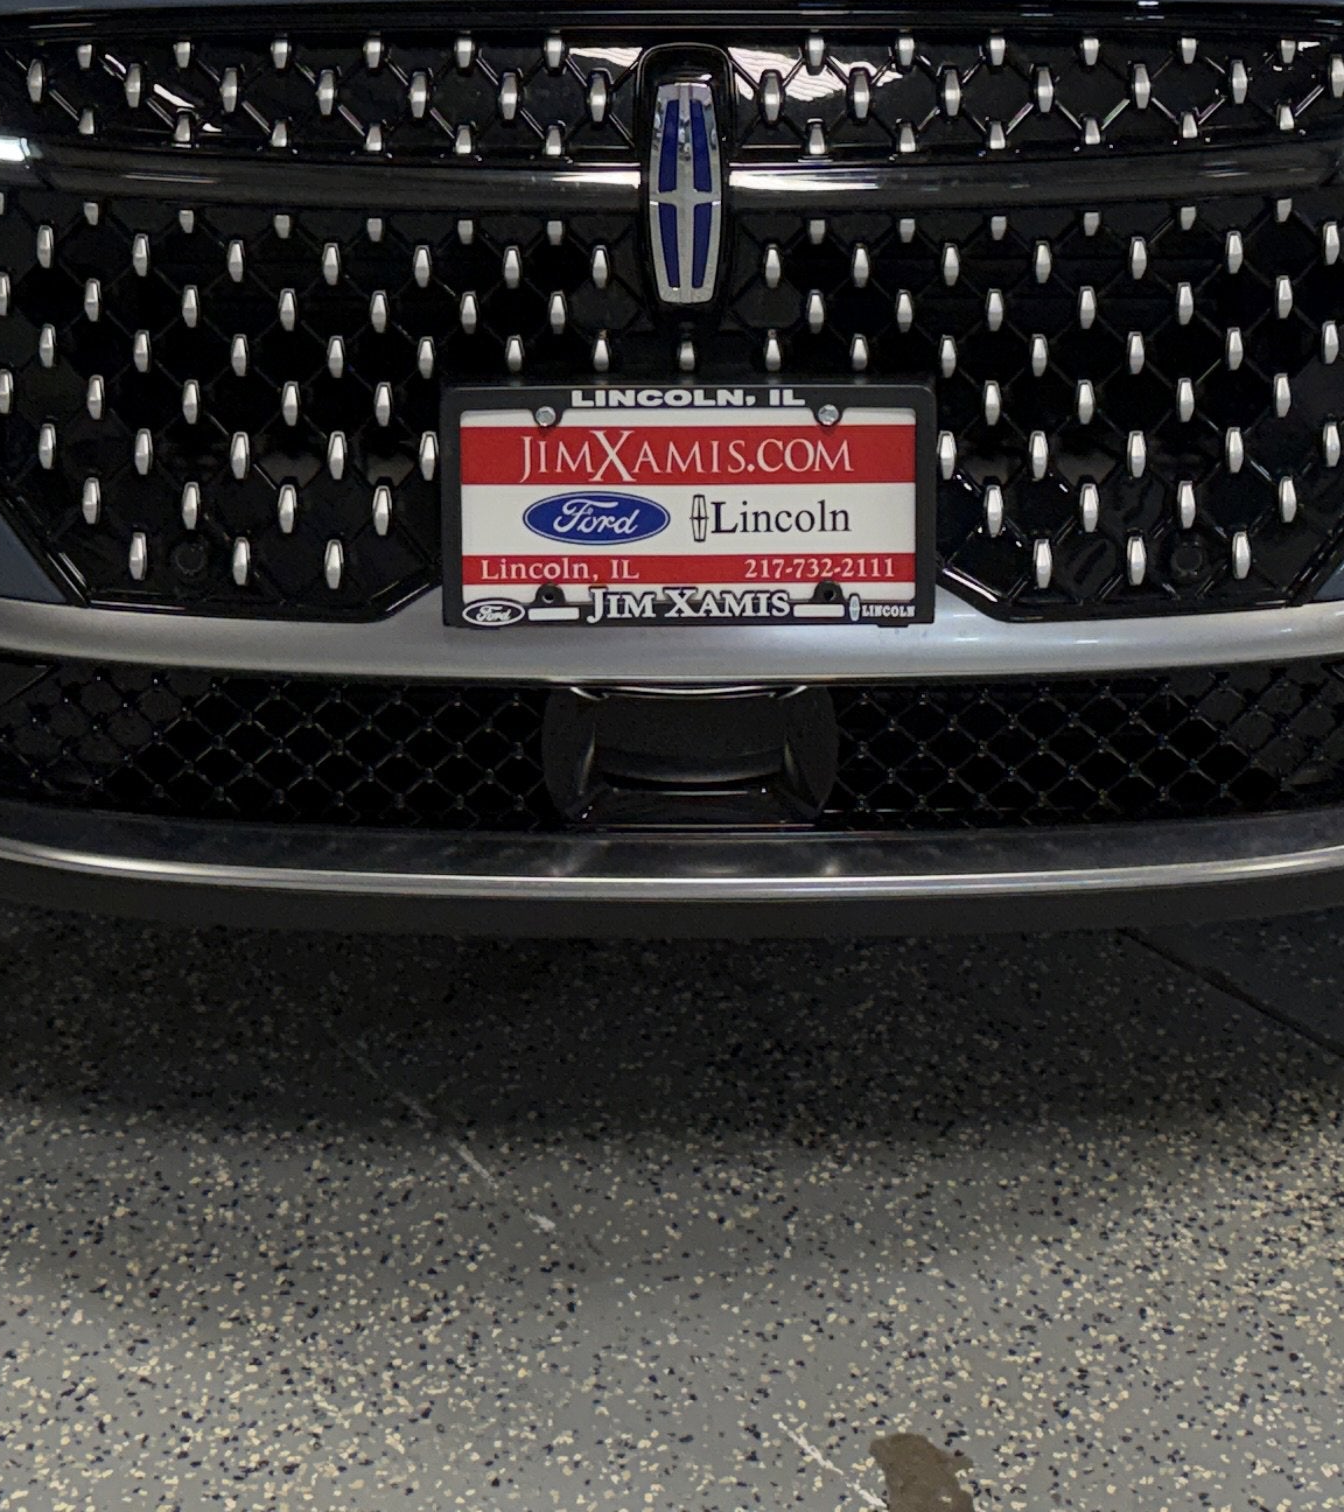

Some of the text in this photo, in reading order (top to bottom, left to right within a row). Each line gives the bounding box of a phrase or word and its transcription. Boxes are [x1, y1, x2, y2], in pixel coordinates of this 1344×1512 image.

[571, 389, 805, 407] LINCOLN, IL
[519, 430, 854, 483] JIMXAMIS.COM
[553, 498, 640, 534] Ford
[710, 500, 852, 533] Lincoln
[481, 558, 640, 581] Lincoln, IL
[744, 558, 895, 579] 217-732-2111
[587, 588, 790, 623] JIM XAMIS
[862, 604, 915, 618] LINCOLN
